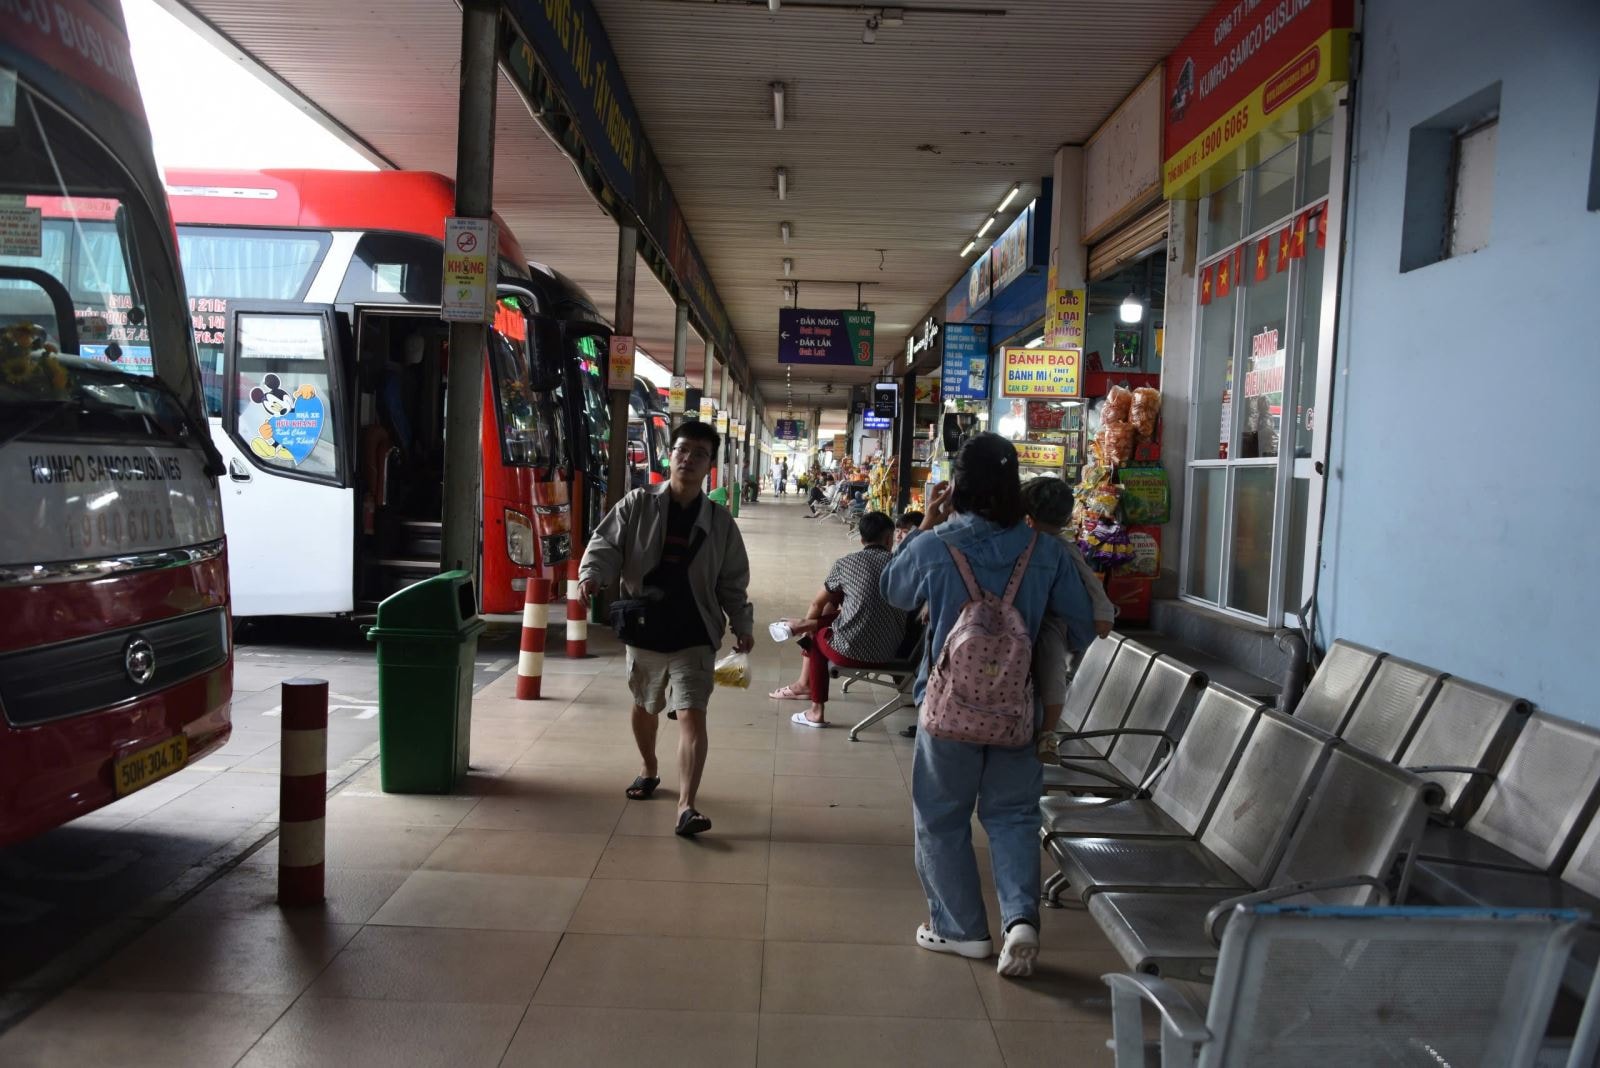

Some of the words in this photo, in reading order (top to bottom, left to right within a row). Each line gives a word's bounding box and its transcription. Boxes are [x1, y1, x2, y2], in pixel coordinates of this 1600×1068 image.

[1214, 16, 1232, 46] CÔNG
[1233, 6, 1243, 27] TY
[1199, 56, 1229, 101] KUMHO
[1229, 23, 1262, 74] SAMCO
[1201, 126, 1222, 160] 1900
[1225, 105, 1249, 142] 6065
[858, 341, 870, 362] 3
[1008, 352, 1044, 364] BÁNH
[1048, 355, 1075, 366] BAO
[1008, 368, 1033, 381] BÁNH
[29, 455, 85, 483] KUMHO
[87, 455, 132, 482] SAMCO
[132, 455, 182, 481] BUSLINES
[121, 741, 184, 787] 50H-304.76
